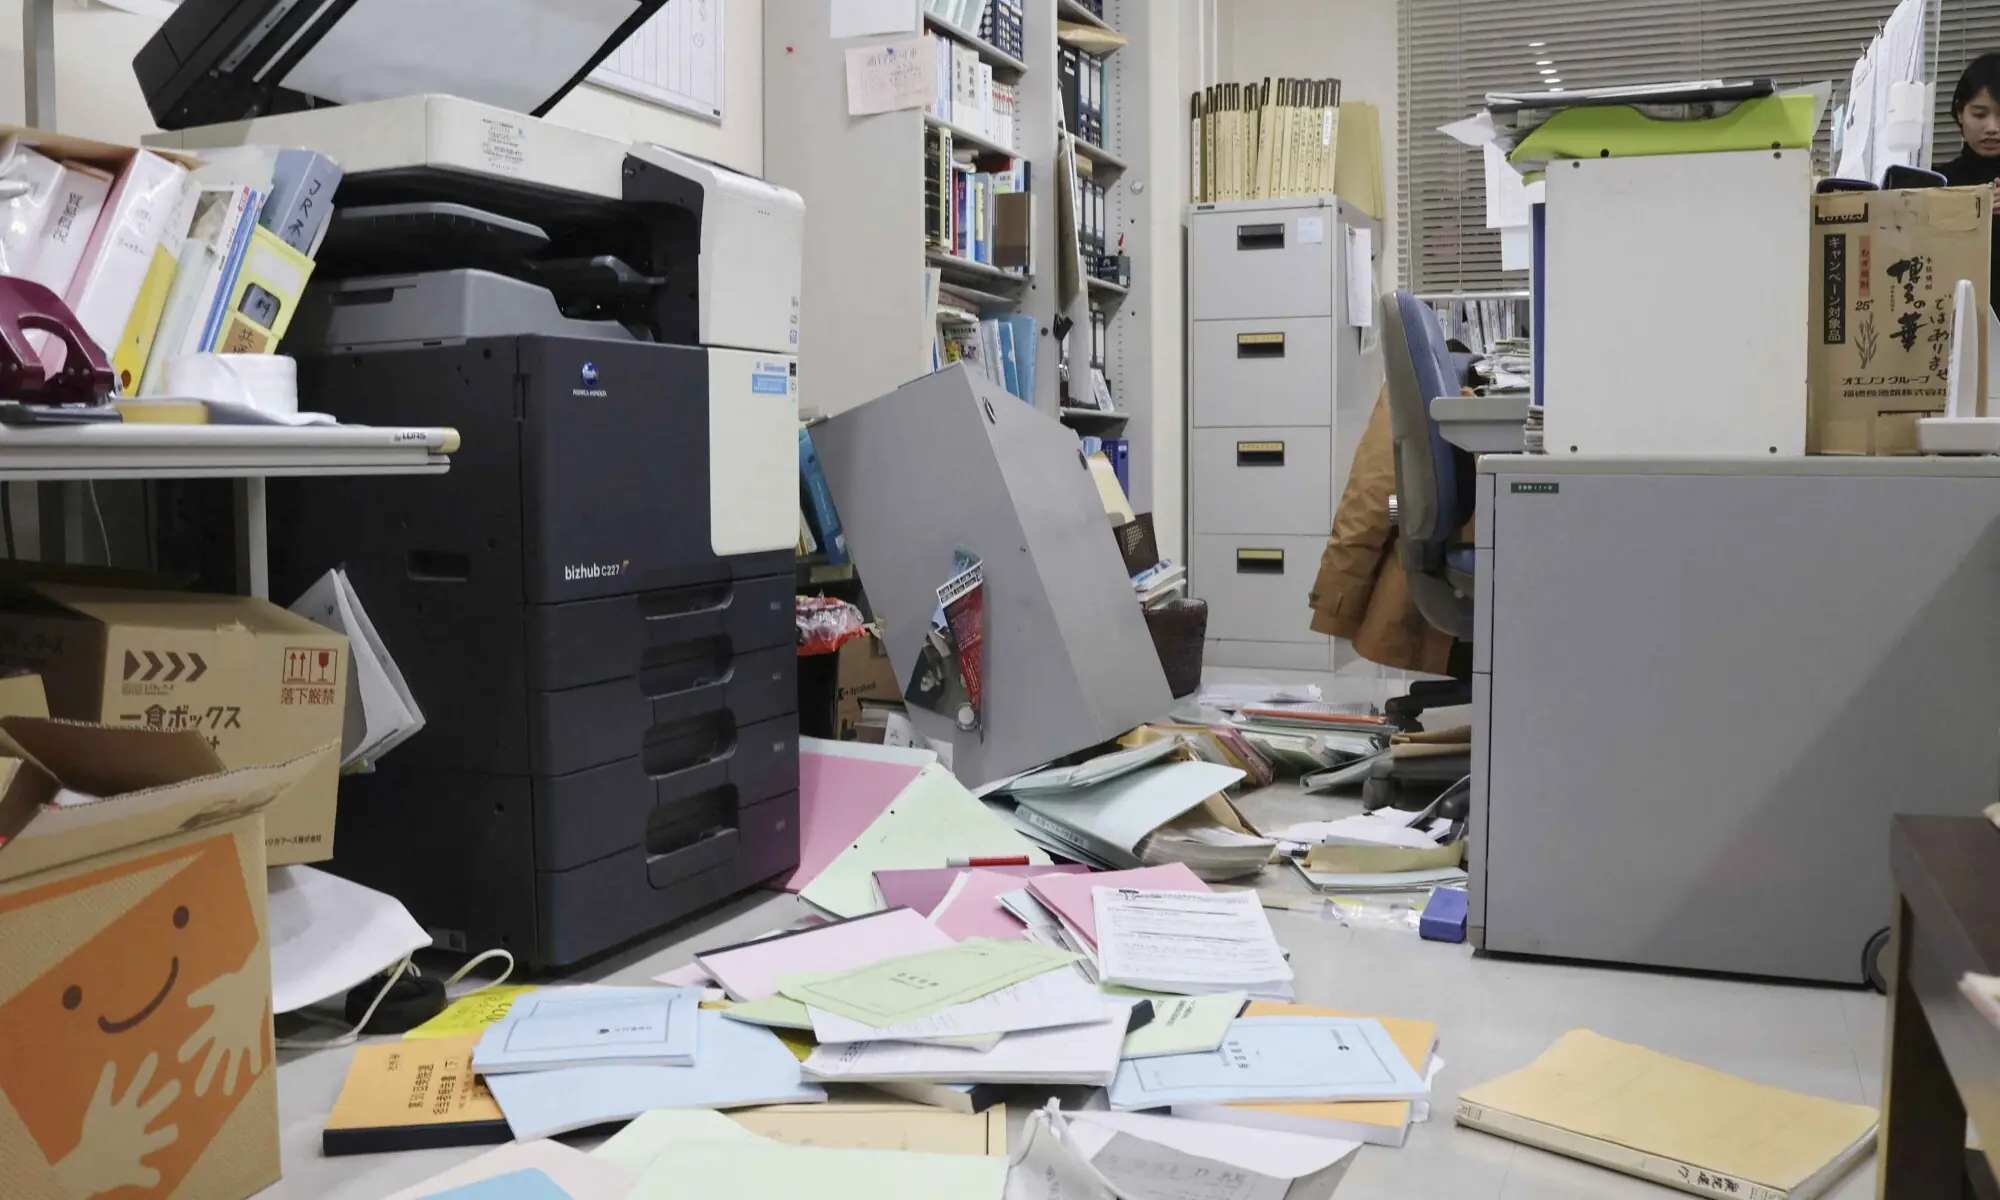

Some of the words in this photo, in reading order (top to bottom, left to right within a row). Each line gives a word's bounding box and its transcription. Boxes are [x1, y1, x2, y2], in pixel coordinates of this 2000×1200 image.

[1828, 237, 1841, 341] キャンペーン対象品
[1886, 256, 1928, 352] 博多の華
[564, 562, 600, 580] bizhub
[281, 687, 335, 705] 落下厳禁
[119, 703, 241, 729] 一食ボックス
[264, 834, 322, 847] リカフーズ株式会社
